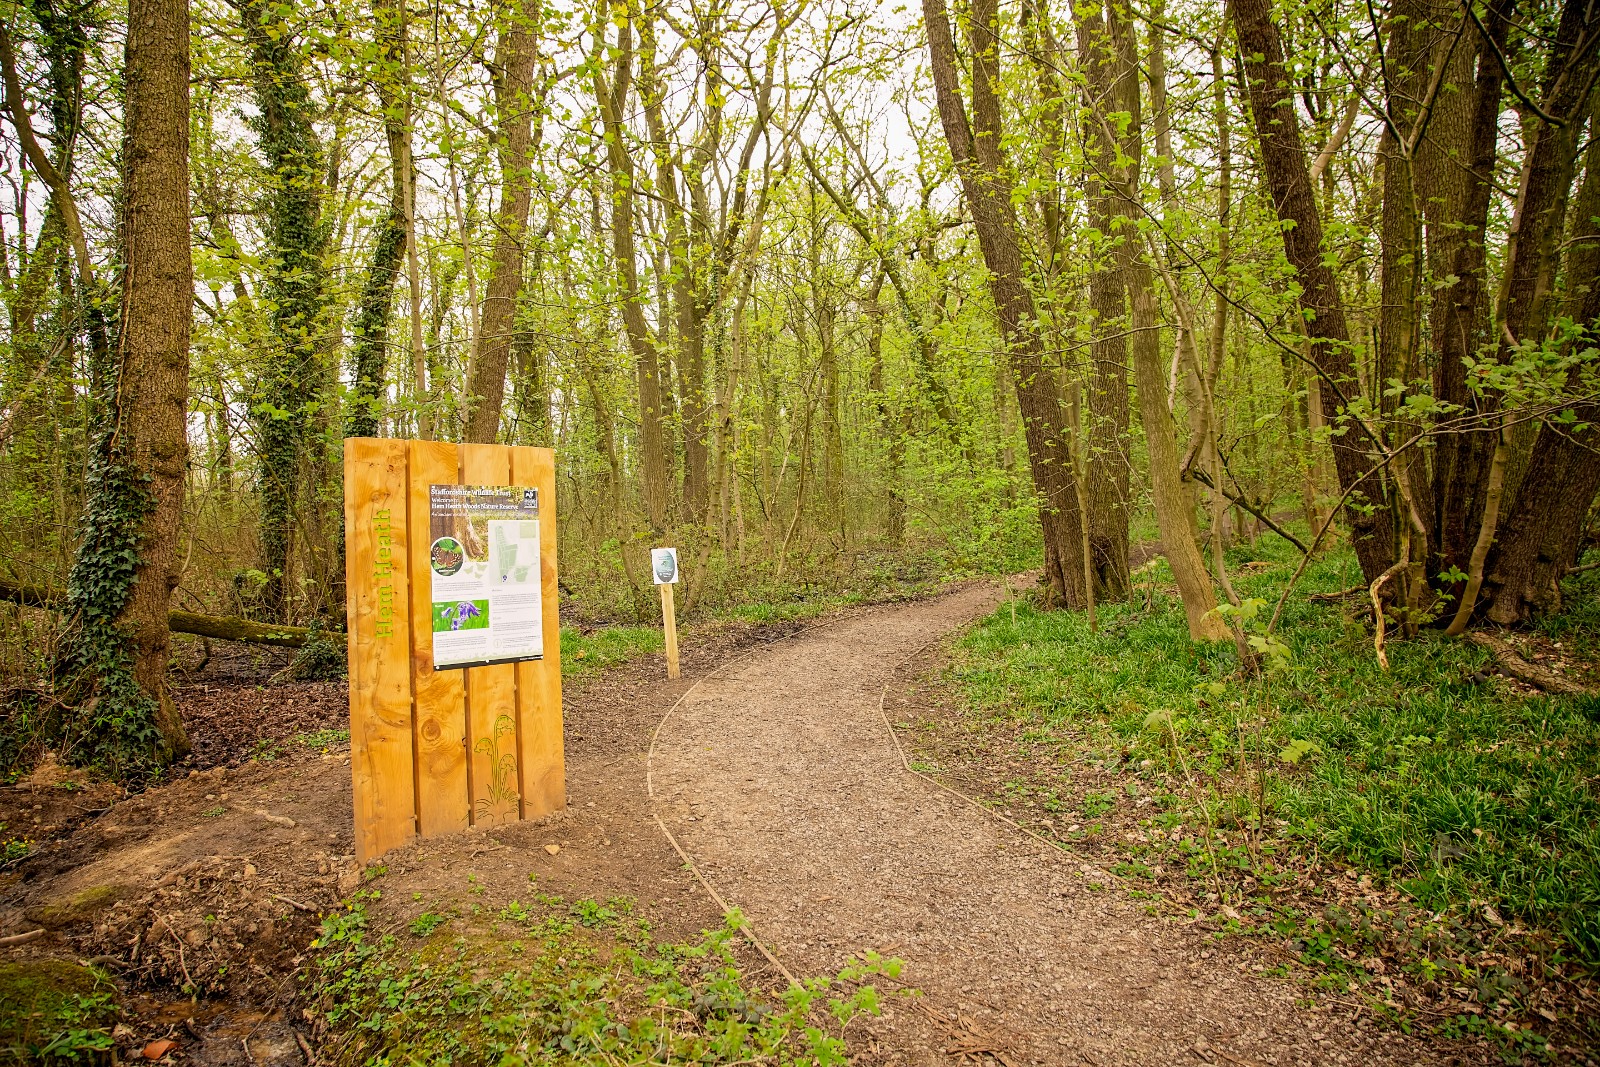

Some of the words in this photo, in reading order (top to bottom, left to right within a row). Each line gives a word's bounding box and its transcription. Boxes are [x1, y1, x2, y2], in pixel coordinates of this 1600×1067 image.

[431, 488, 471, 496] Staffordshire
[496, 489, 511, 498] Trust
[373, 509, 392, 579] Heath
[375, 585, 393, 638] Hem
